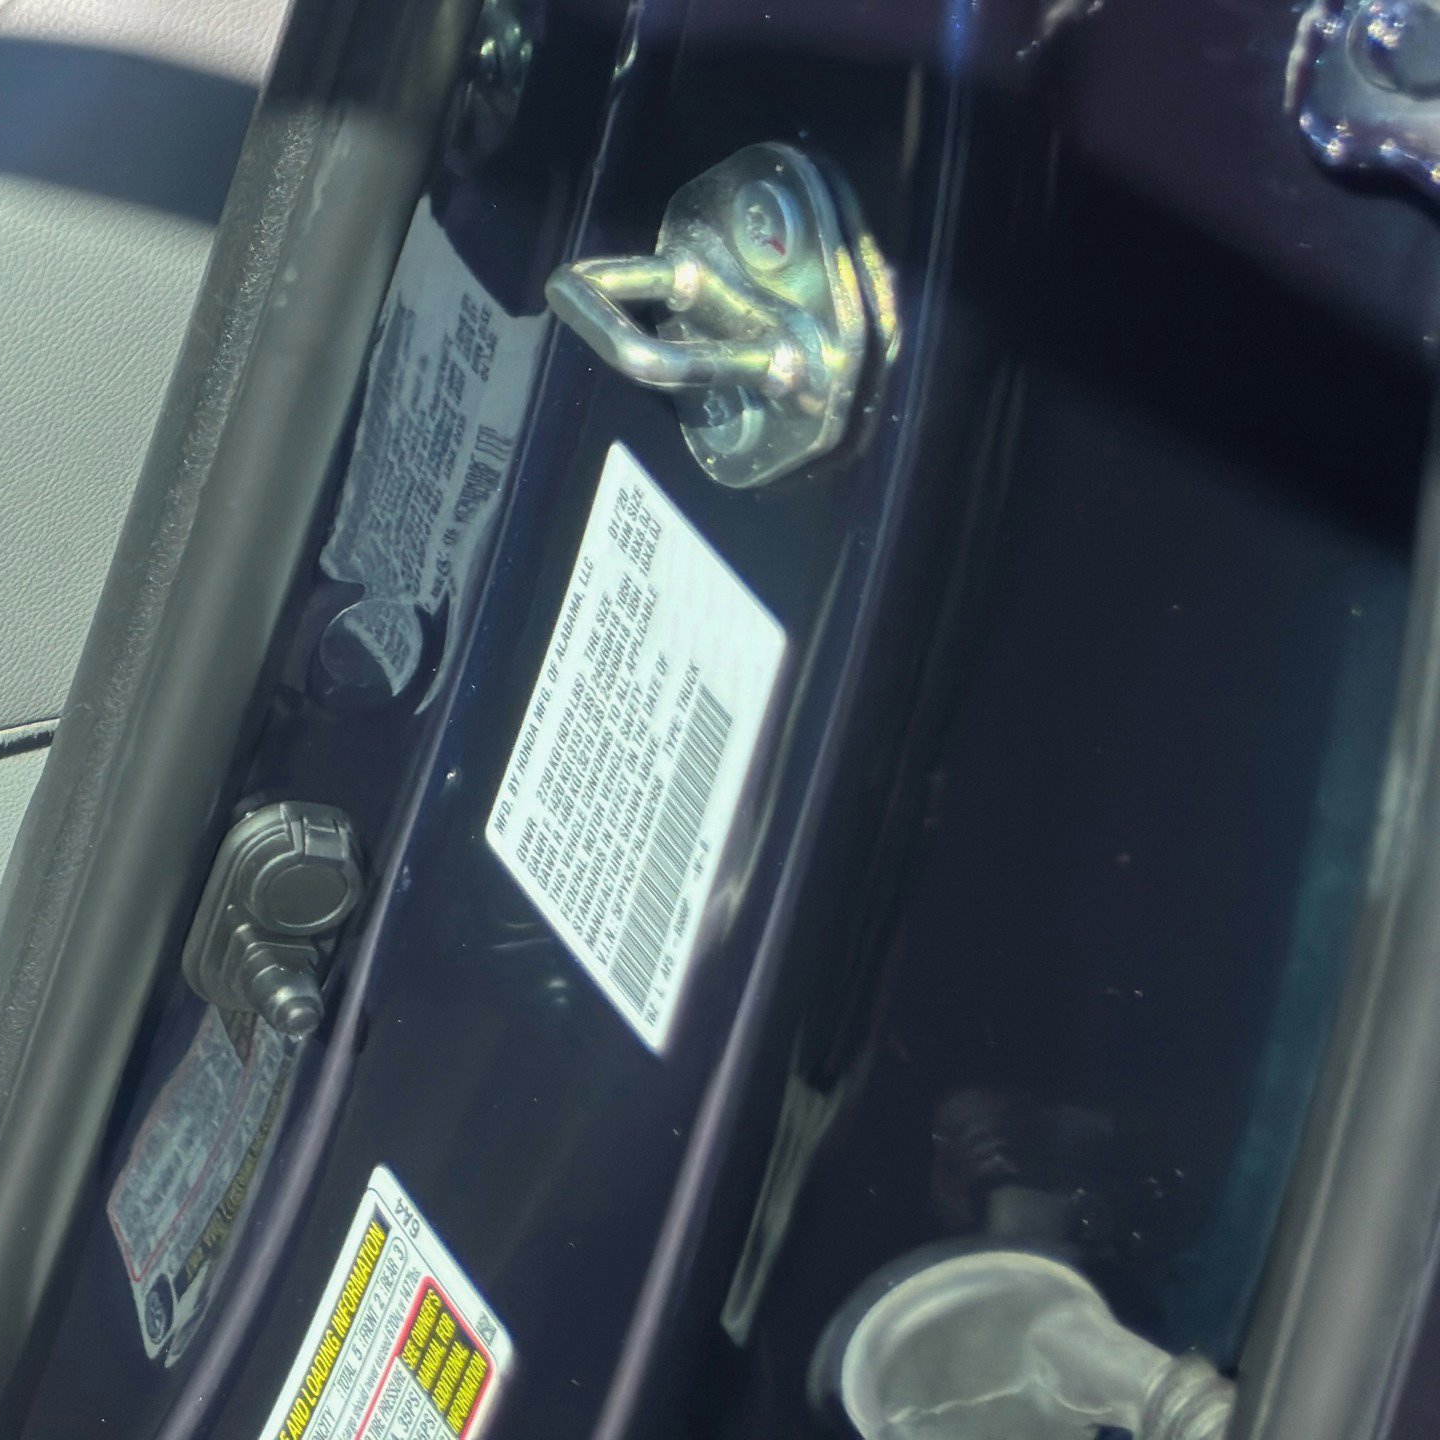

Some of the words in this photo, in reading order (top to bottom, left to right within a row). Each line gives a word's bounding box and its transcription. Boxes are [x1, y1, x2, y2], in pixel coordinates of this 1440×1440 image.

[493, 799, 513, 835] MFD.
[507, 771, 520, 797] BY
[515, 722, 539, 775] HONDA
[532, 686, 553, 723] MFG.
[546, 659, 559, 683] OF
[554, 591, 585, 662] ALABAMA,
[577, 555, 594, 588] LLC
[516, 816, 538, 864] GVWR
[535, 766, 554, 805] 2730
[583, 629, 601, 662] TIRE
[595, 594, 612, 628] SIZE
[617, 519, 634, 554] RIM
[626, 487, 644, 522] SIZE
[642, 678, 662, 718] DATE
[655, 654, 669, 677] OF
[526, 830, 549, 878] GAWR
[541, 820, 552, 834] F
[547, 780, 565, 817] 1420
[590, 610, 621, 688] 245/60R18
[548, 867, 567, 904] THIS
[559, 810, 587, 869] VEHICLE
[581, 725, 614, 809] CONFORMS
[607, 703, 621, 726] TO
[614, 675, 631, 706] ALL
[624, 586, 658, 676] APPLICABLE
[631, 714, 649, 748] THE
[662, 714, 683, 758] TYPE:
[676, 659, 700, 712] TRUCK
[624, 747, 639, 774] ON
[559, 857, 588, 921] FEDERAL
[581, 801, 606, 856] MOTOR
[598, 741, 626, 802] VEHICLE
[619, 681, 643, 741] SAFETY
[600, 827, 614, 849] IN
[606, 772, 631, 830] EFFECT
[537, 843, 559, 891] GAWR
[551, 828, 564, 846] R
[584, 844, 625, 951] MANUFACTURE
[618, 783, 644, 843] SHOWN
[637, 736, 661, 787] ABOVE.
[571, 846, 607, 936] STANDARDS
[286, 1398, 311, 1440] AND
[303, 1330, 342, 1406] LOADING
[332, 1223, 386, 1338] INFORMATION
[336, 1360, 357, 1394] TOTAL
[350, 1342, 363, 1361] 5
[358, 1303, 379, 1344] FRONT
[372, 1291, 386, 1311] 2
[379, 1256, 399, 1293] REAR
[392, 1243, 405, 1261] 3
[401, 1338, 422, 1370] SEE
[410, 1291, 441, 1349] OWNER'S
[418, 1338, 447, 1389] MANUAL
[434, 1312, 455, 1344] FOR
[367, 1412, 386, 1440] TIRE
[377, 1364, 407, 1422] PRESSURE
[396, 1385, 422, 1433] 35PSI
[433, 1341, 470, 1411] ADDITIONAL
[448, 1352, 486, 1431] INFORMATION
